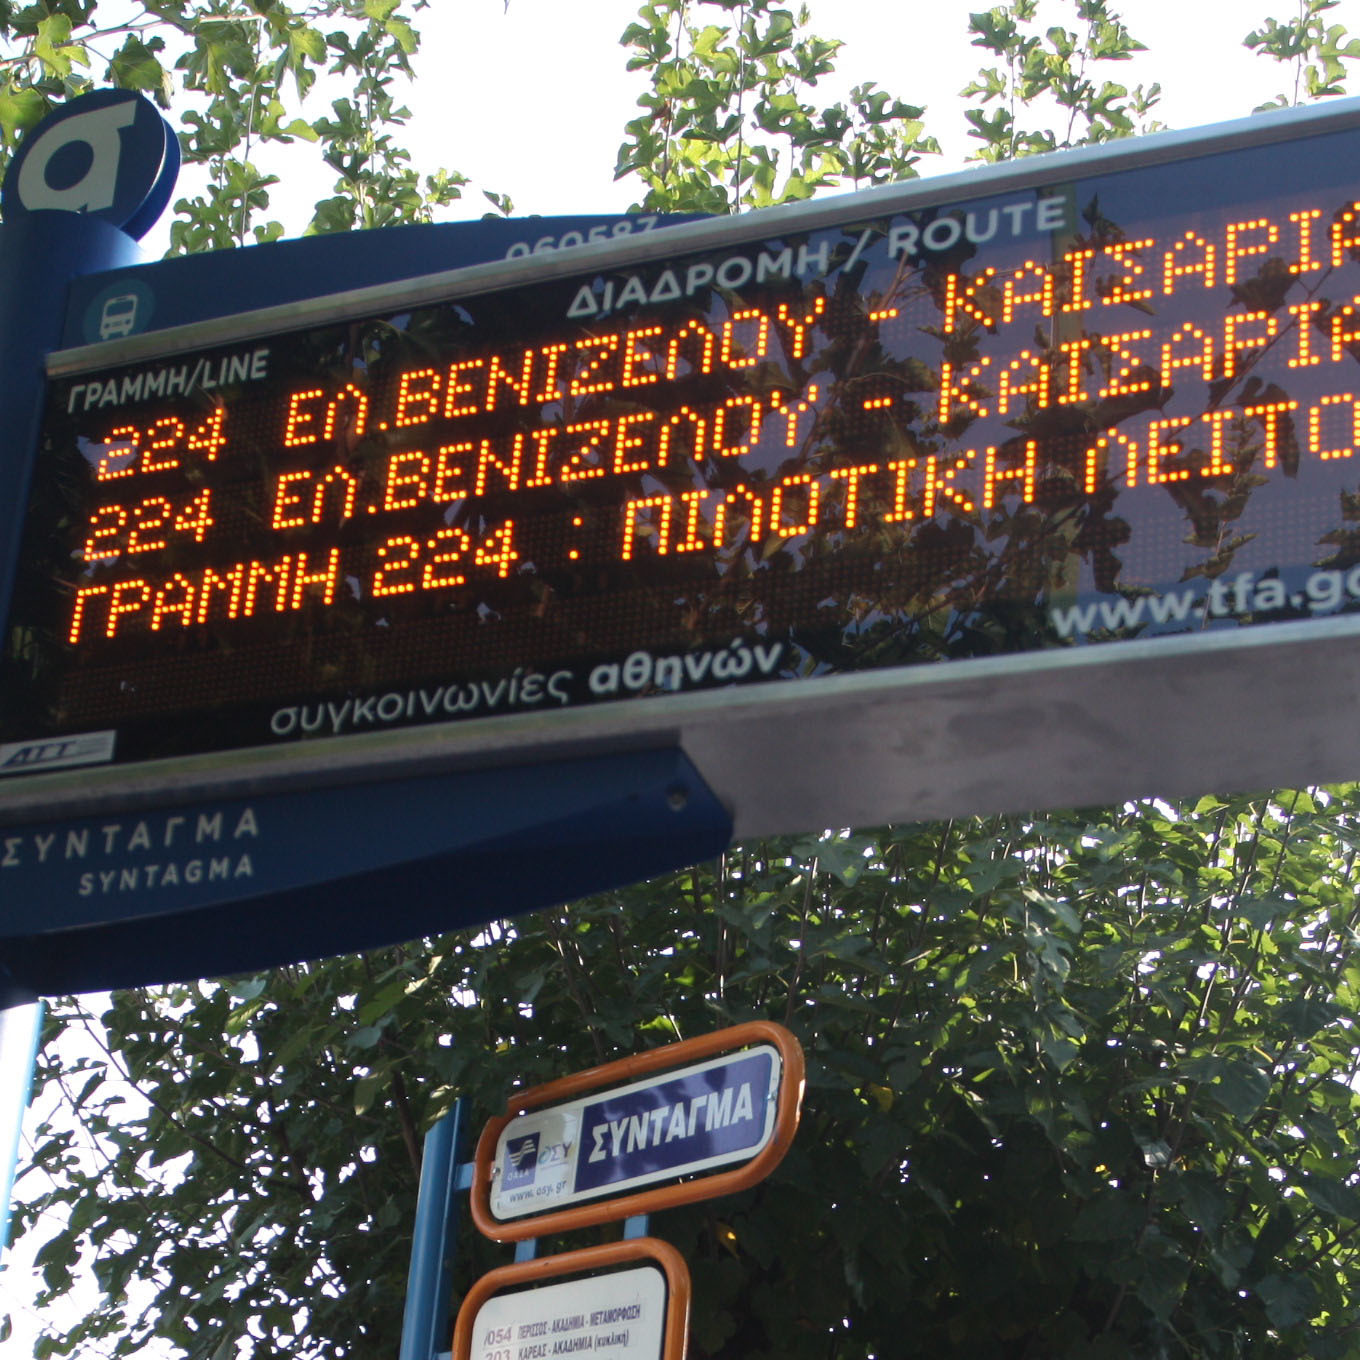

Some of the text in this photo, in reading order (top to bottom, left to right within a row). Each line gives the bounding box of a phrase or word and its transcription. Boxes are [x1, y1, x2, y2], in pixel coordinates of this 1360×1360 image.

[567, 238, 836, 318] ΔΙΑΔΡΟΜΗ
[887, 196, 1066, 260] ROUTE
[68, 348, 268, 414] ΓΡΑΜΜΗ/LINE
[98, 406, 226, 481] 224
[68, 548, 340, 645] ΓΡΑΜΜΗ
[372, 520, 518, 598] 224
[620, 438, 1038, 561] ΠΙΛΟΤΙΚΗ
[83, 488, 215, 562] 224
[270, 641, 784, 737] συγκοινωνίες αθηνών
[1, 807, 261, 868] ΣΥΝΤΑΓΜΑ
[79, 855, 255, 896] SYNTAGMA
[588, 1082, 754, 1163] ΣΥΝΤΑΓΜΑ
[518, 1344, 546, 1360] ΚΑΡΕΑΣ
[552, 1336, 593, 1355] ΑΚΑΔΗΜΙΑ
